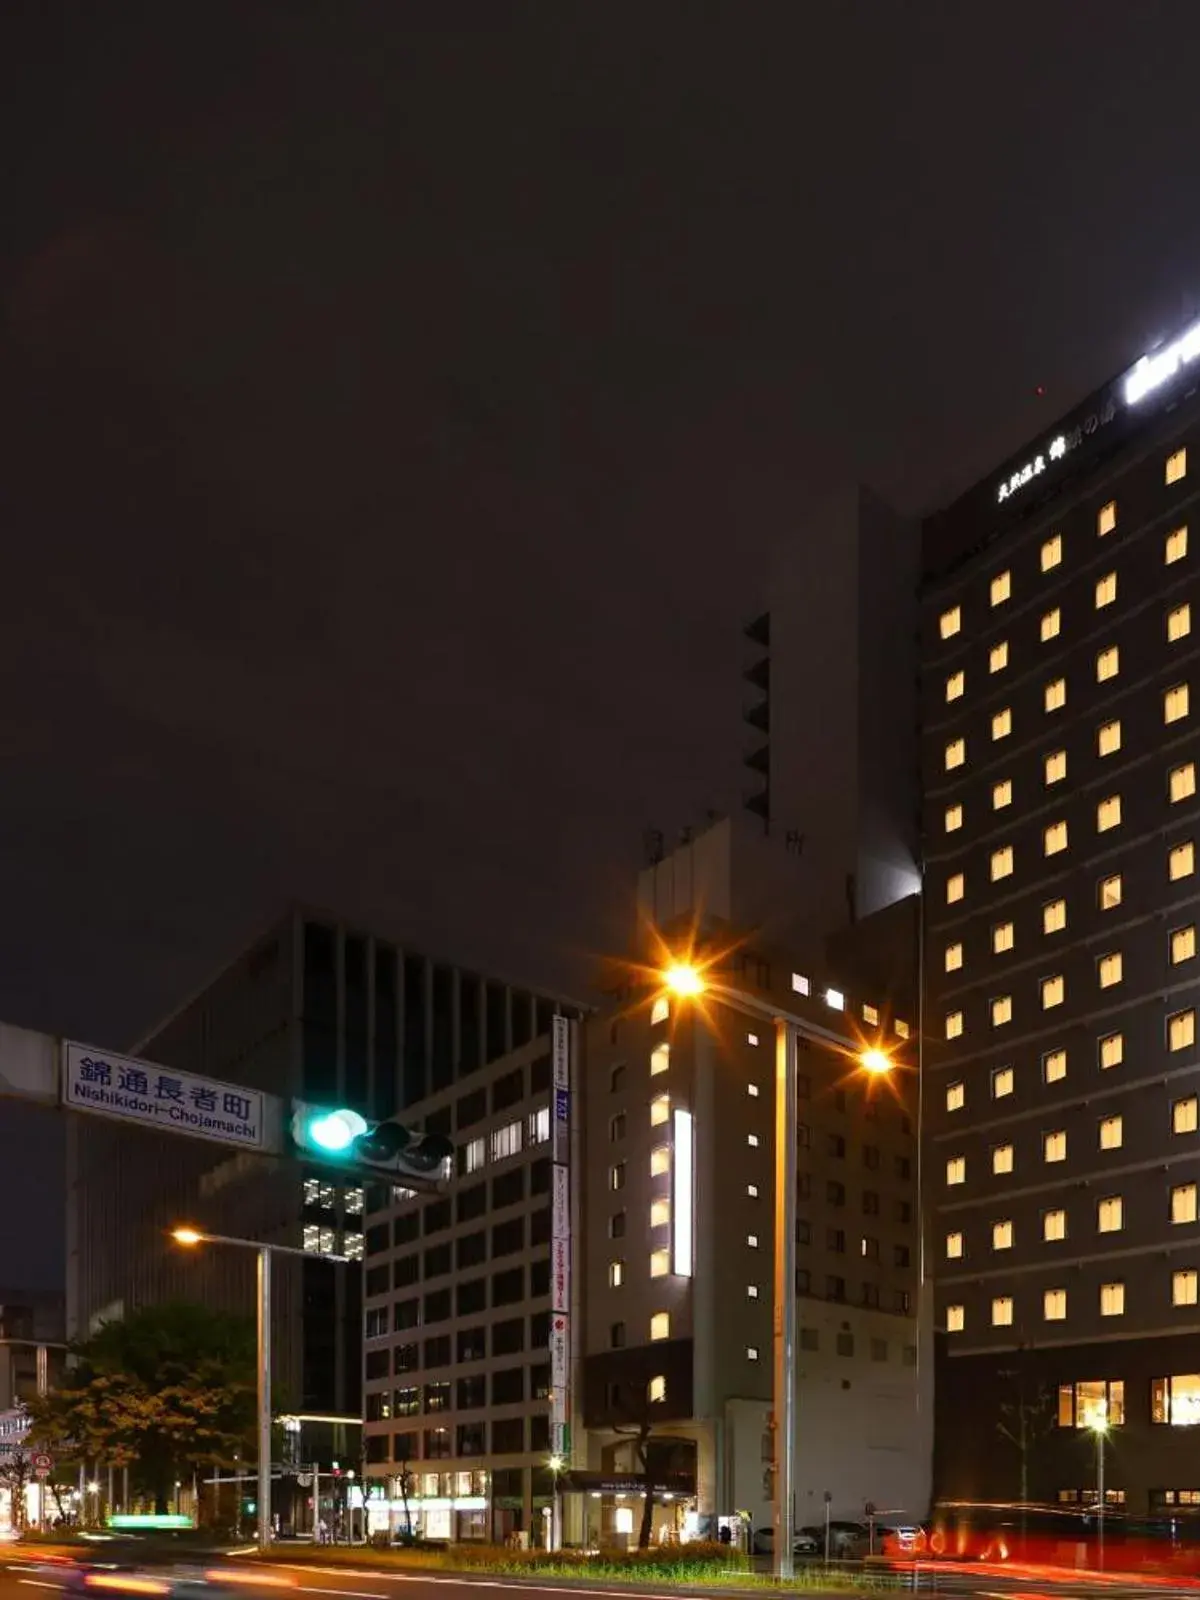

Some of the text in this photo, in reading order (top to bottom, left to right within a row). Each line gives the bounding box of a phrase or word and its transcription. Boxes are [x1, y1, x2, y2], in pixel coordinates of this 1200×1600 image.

[74, 1082, 257, 1139] Nishikidori-Chojamachi
[80, 1056, 252, 1121] 錦通長者町
